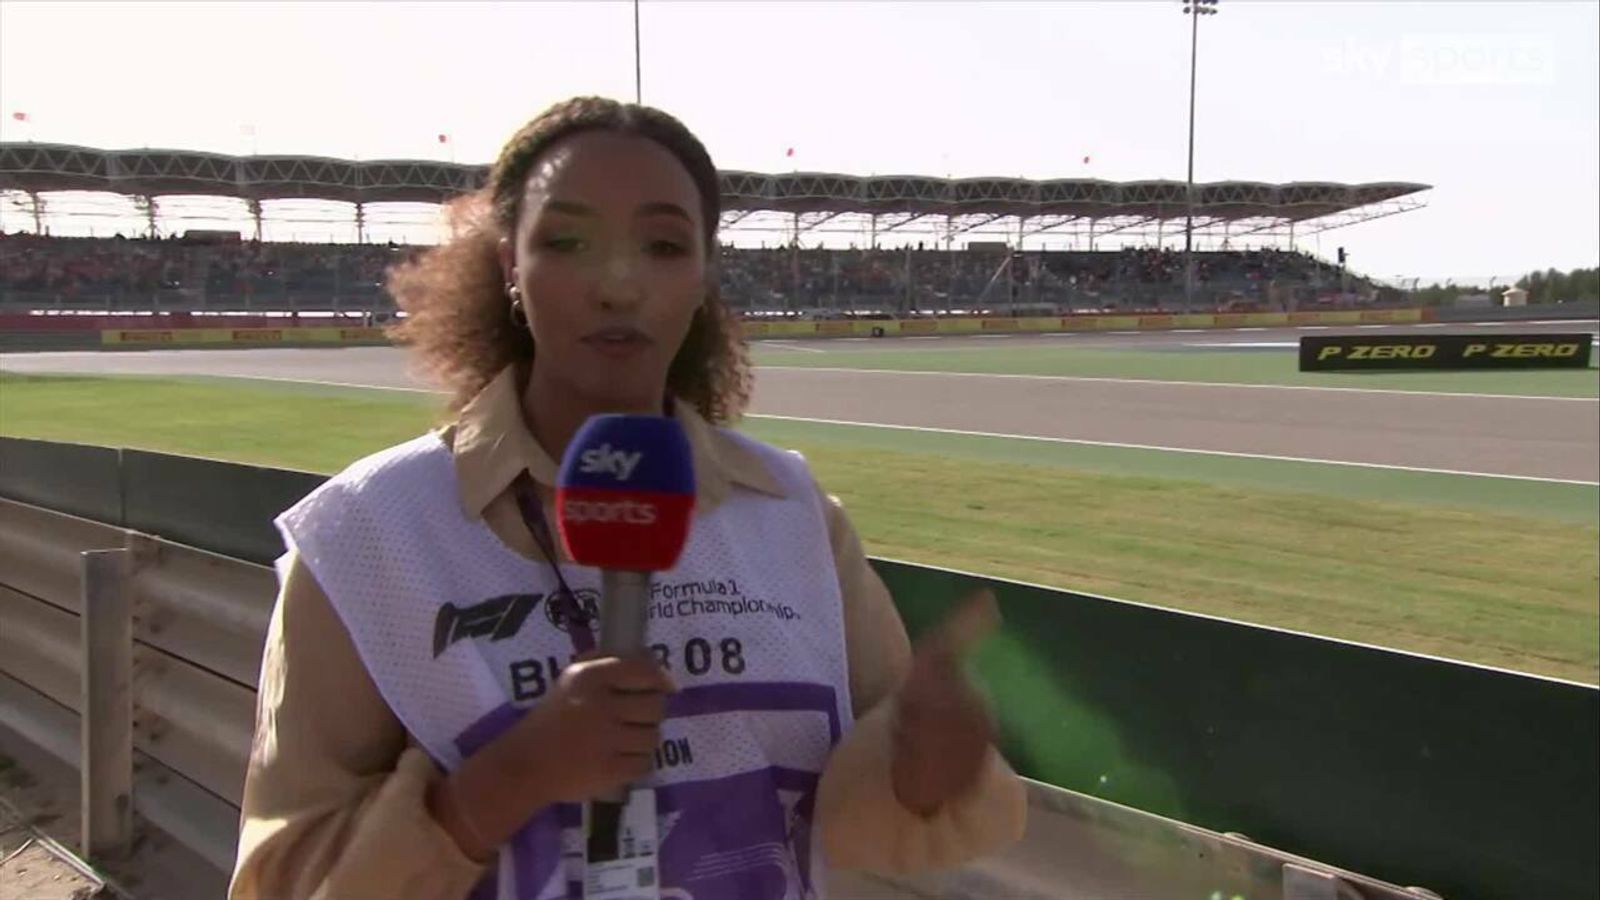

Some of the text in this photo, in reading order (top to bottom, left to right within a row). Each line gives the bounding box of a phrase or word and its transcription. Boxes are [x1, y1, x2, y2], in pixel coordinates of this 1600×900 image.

[1318, 345, 1437, 360] P ZERO
[1464, 343, 1579, 357] P ZERO
[579, 443, 642, 481] sky
[565, 500, 656, 525] sports
[650, 580, 726, 599] Formula
[650, 602, 673, 619] rld
[655, 737, 693, 769] ION
